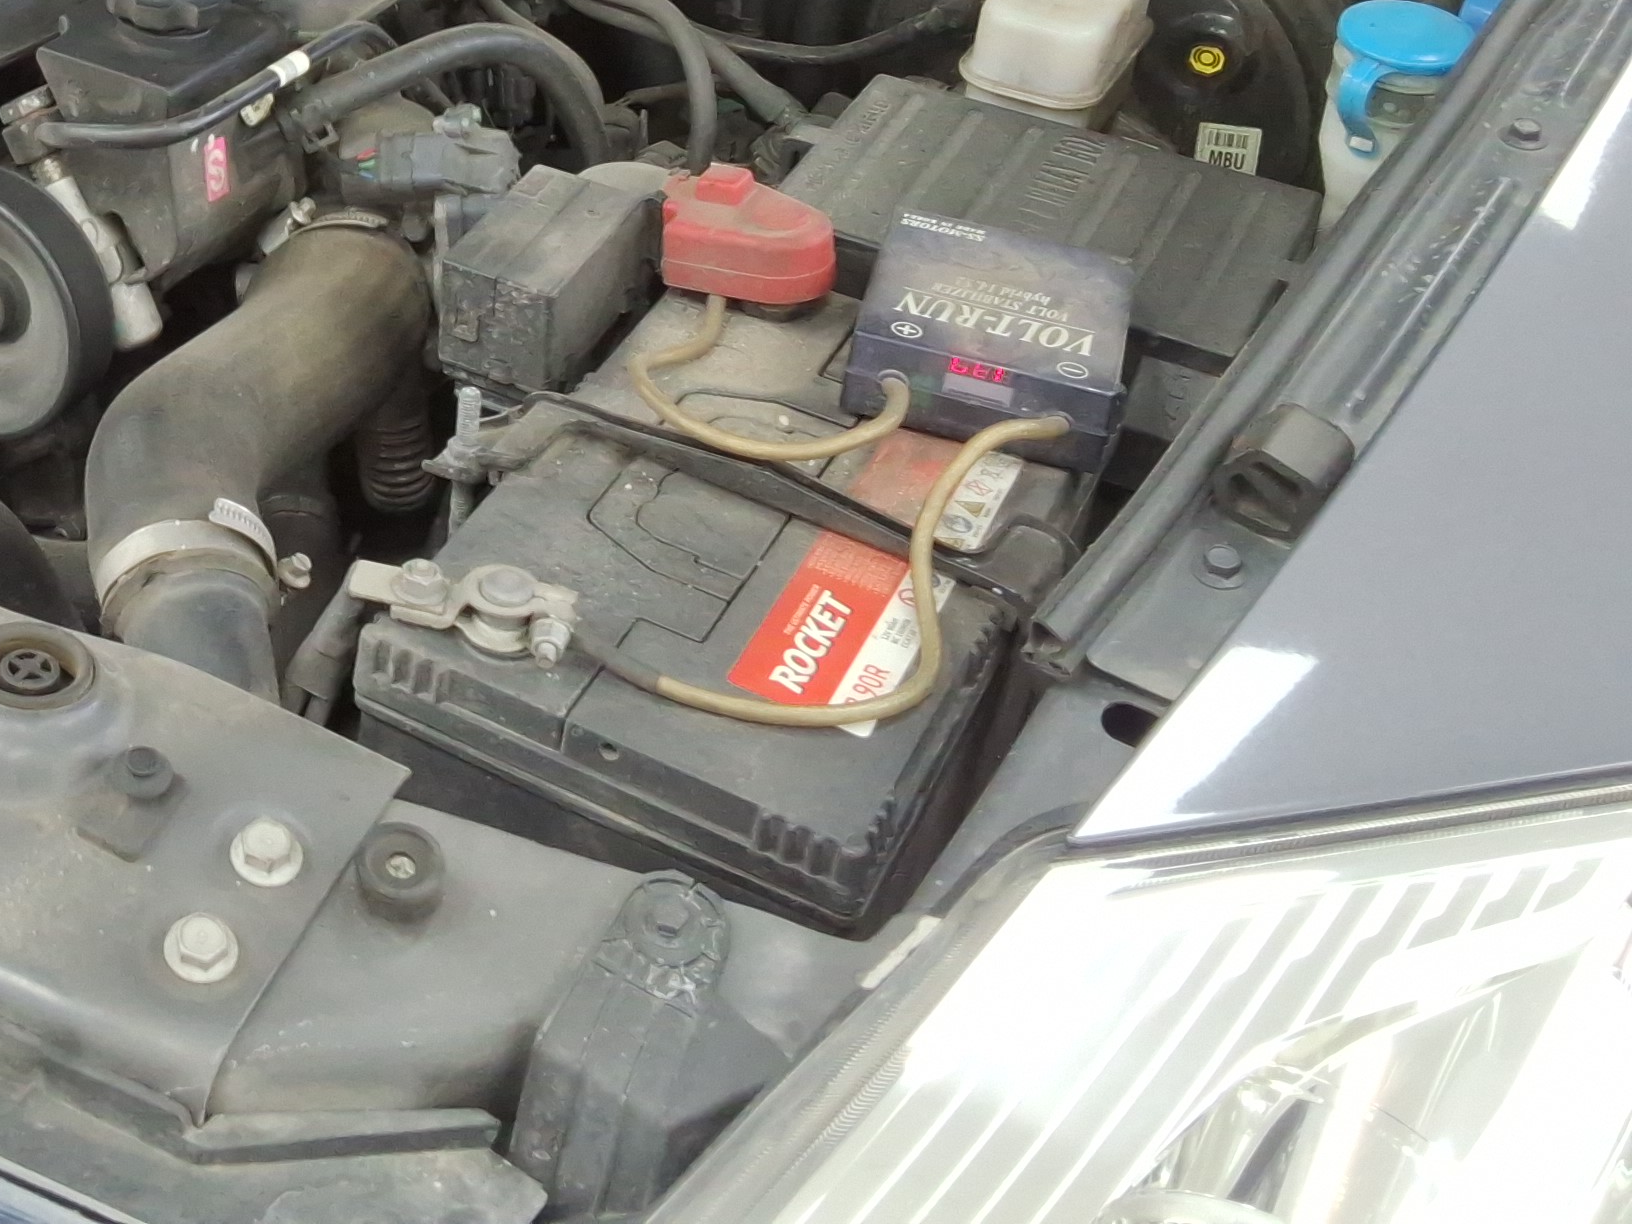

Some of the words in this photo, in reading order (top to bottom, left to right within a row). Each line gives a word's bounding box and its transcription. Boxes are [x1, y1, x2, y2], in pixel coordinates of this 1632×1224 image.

[1208, 149, 1246, 170] MBU
[931, 281, 1024, 312] STABILIZER
[892, 291, 1094, 357] VOLT-RUN
[1026, 305, 1068, 322] VOLT
[768, 589, 853, 696] ROCKET
